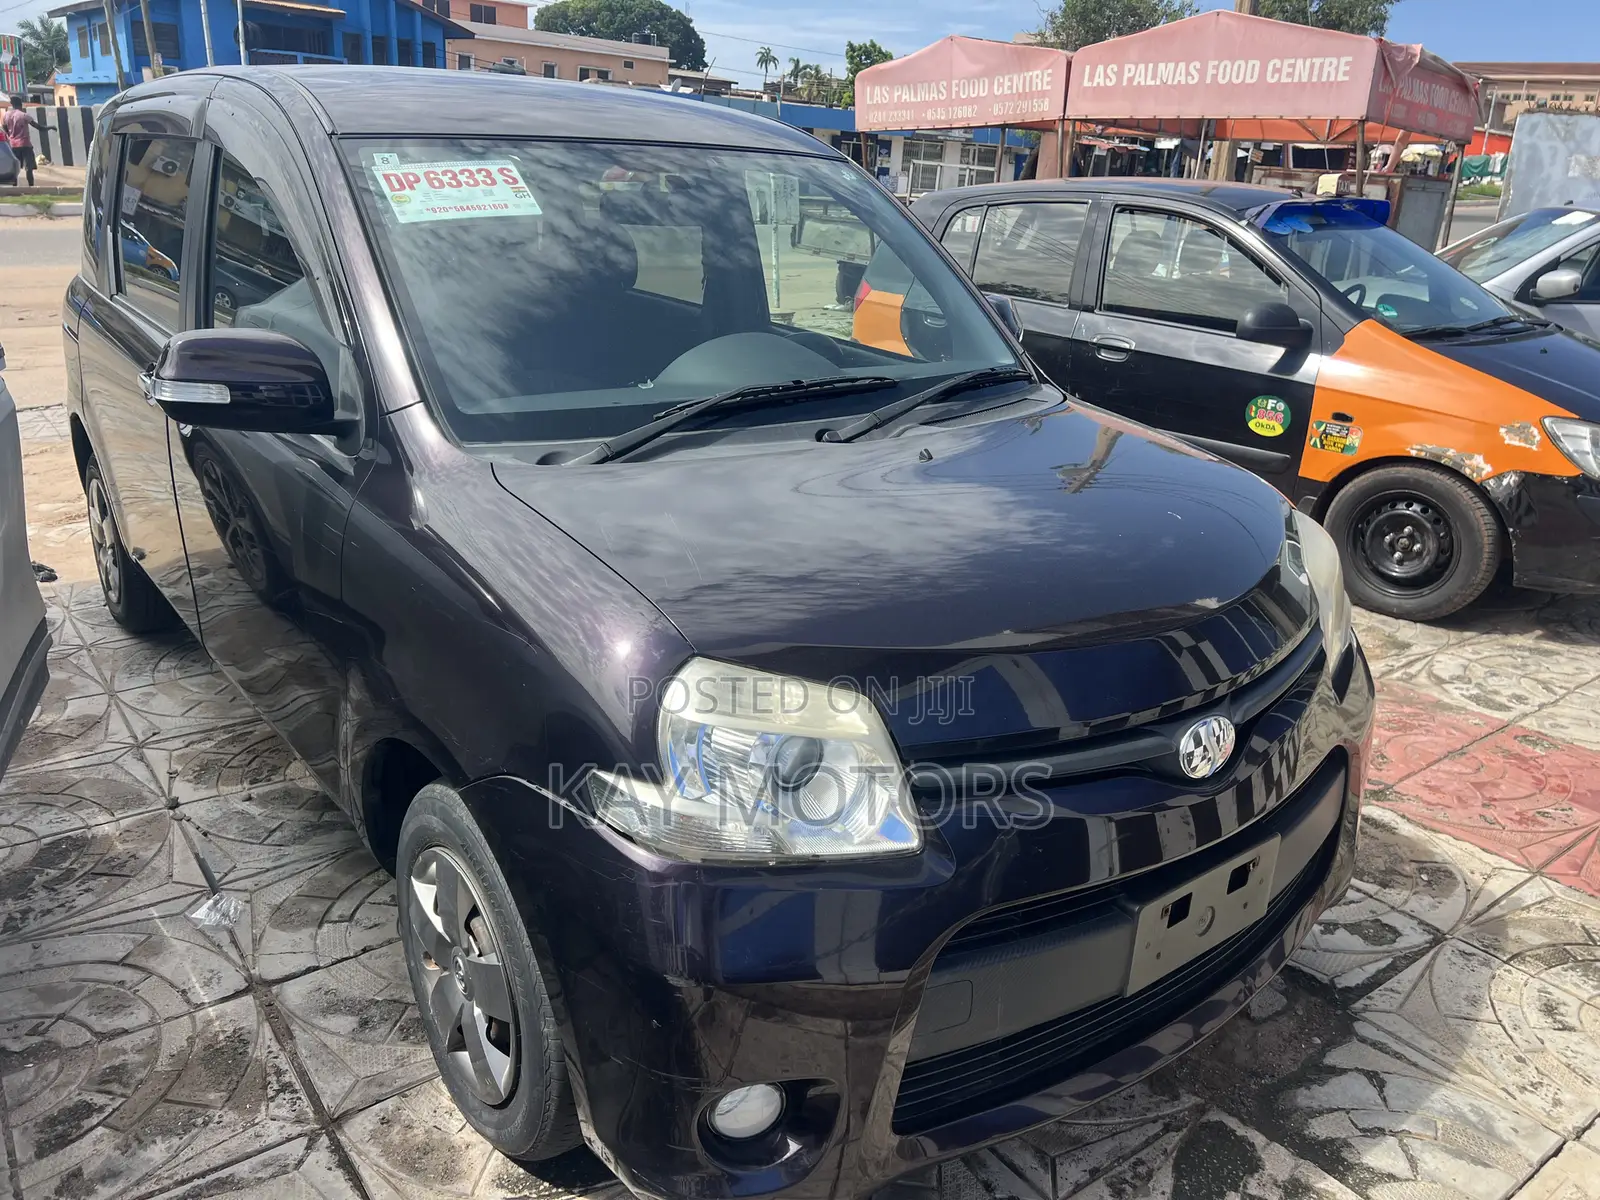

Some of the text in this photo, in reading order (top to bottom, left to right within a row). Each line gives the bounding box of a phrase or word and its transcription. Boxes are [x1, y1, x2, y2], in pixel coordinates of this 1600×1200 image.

[1083, 56, 1353, 87] LAS PALMAS FOOD CENTRE
[866, 69, 1053, 105] LAS PALMAS FOOD CENTRE
[993, 101, 1014, 116] 0572
[382, 167, 519, 192] DP 6333 S
[514, 192, 532, 200] GH
[1256, 408, 1284, 425] 856
